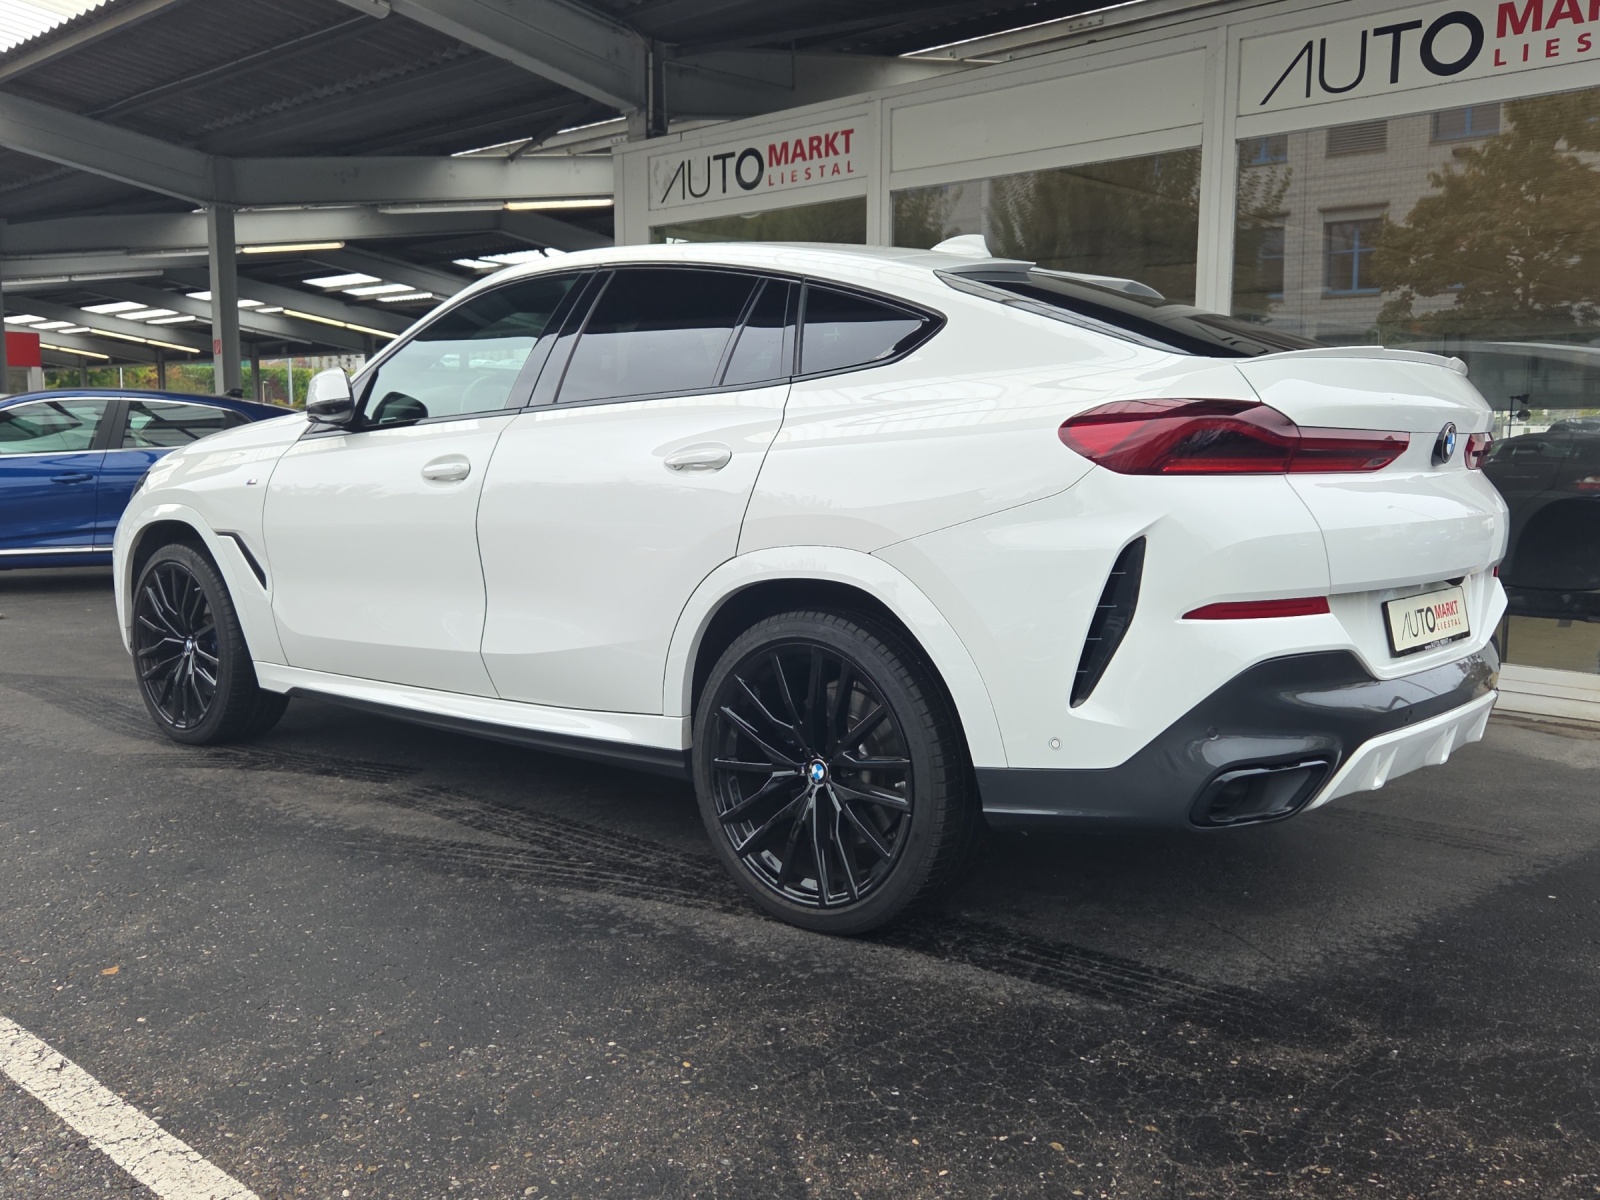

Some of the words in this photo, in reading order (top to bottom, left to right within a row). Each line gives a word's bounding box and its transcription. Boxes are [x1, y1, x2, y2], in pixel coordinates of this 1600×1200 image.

[1259, 10, 1485, 106] AUTO
[1494, 32, 1593, 67] LIES
[661, 147, 765, 204] AUTO
[768, 128, 855, 168] MARKT
[768, 160, 855, 187] LIESTAL
[1402, 606, 1436, 640] AUTO
[1434, 600, 1459, 619] MARKT
[1437, 618, 1461, 631] LIESTAL
